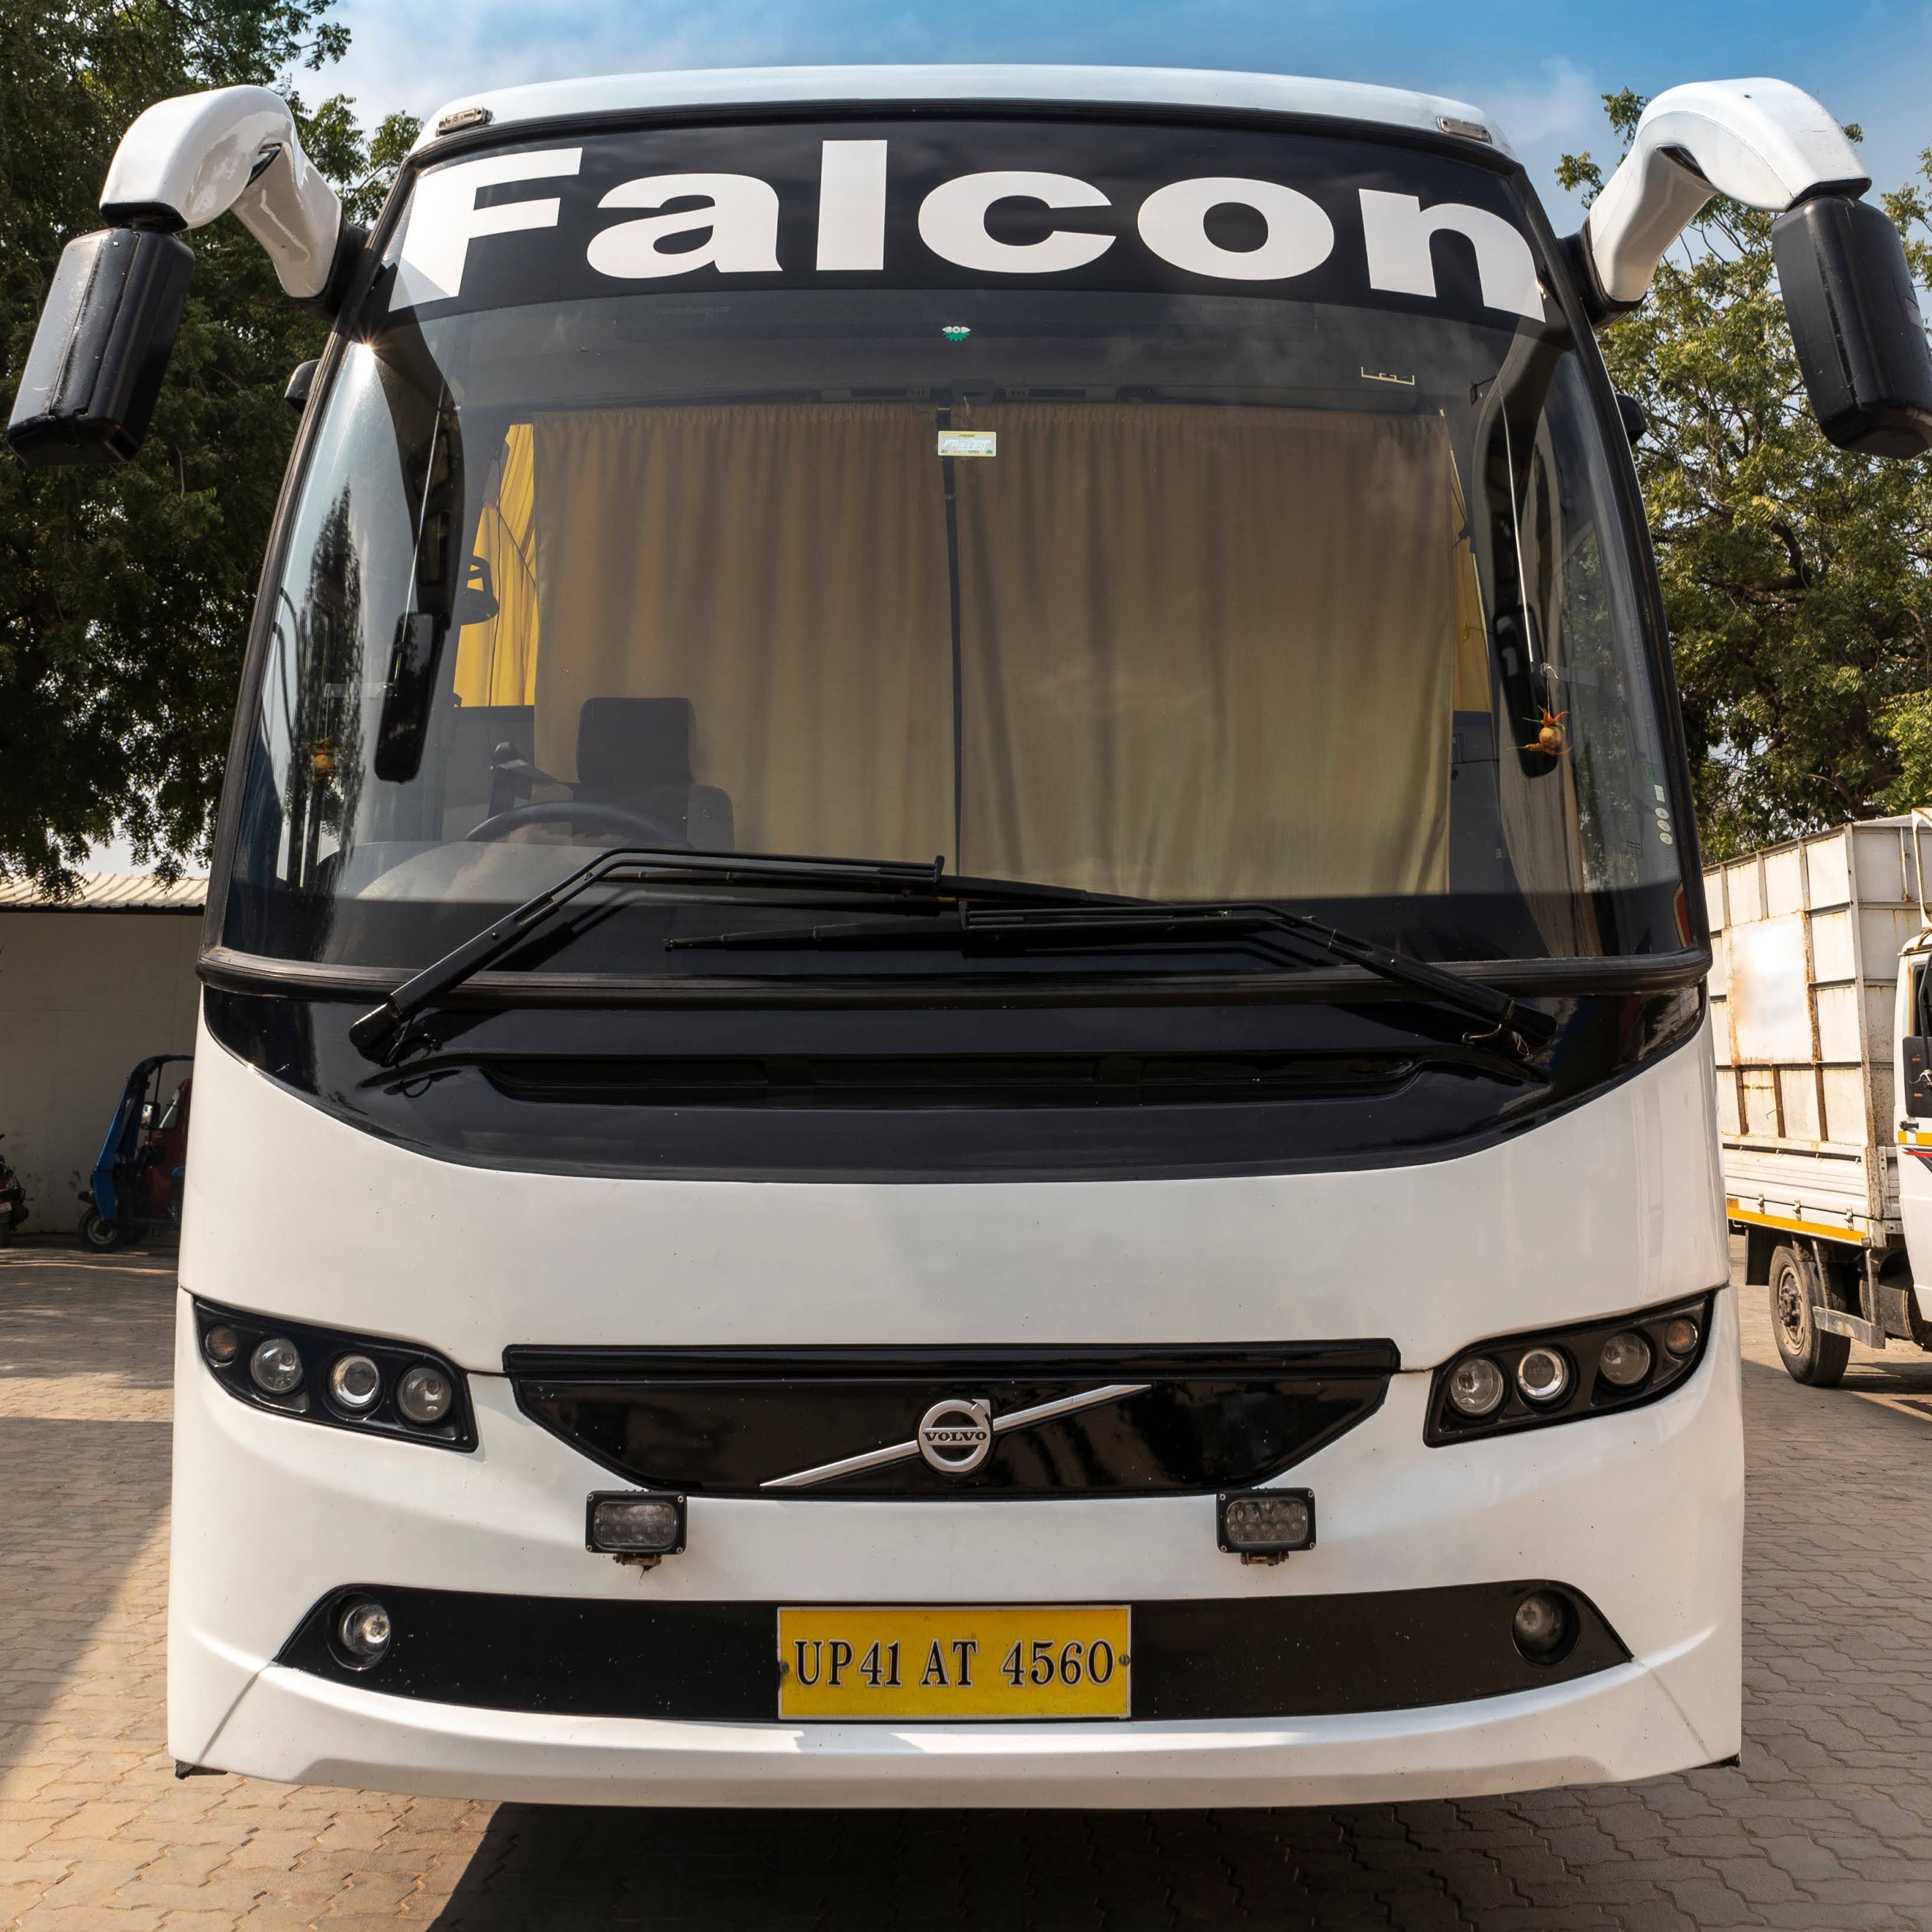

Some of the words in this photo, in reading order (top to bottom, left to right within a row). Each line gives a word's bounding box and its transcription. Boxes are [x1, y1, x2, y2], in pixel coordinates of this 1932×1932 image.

[389, 139, 1546, 322] Falcon
[922, 1431, 988, 1442] VOLVO
[793, 1639, 902, 1688] UP41
[919, 1638, 978, 1687] AT
[1001, 1640, 1115, 1687] 4560
